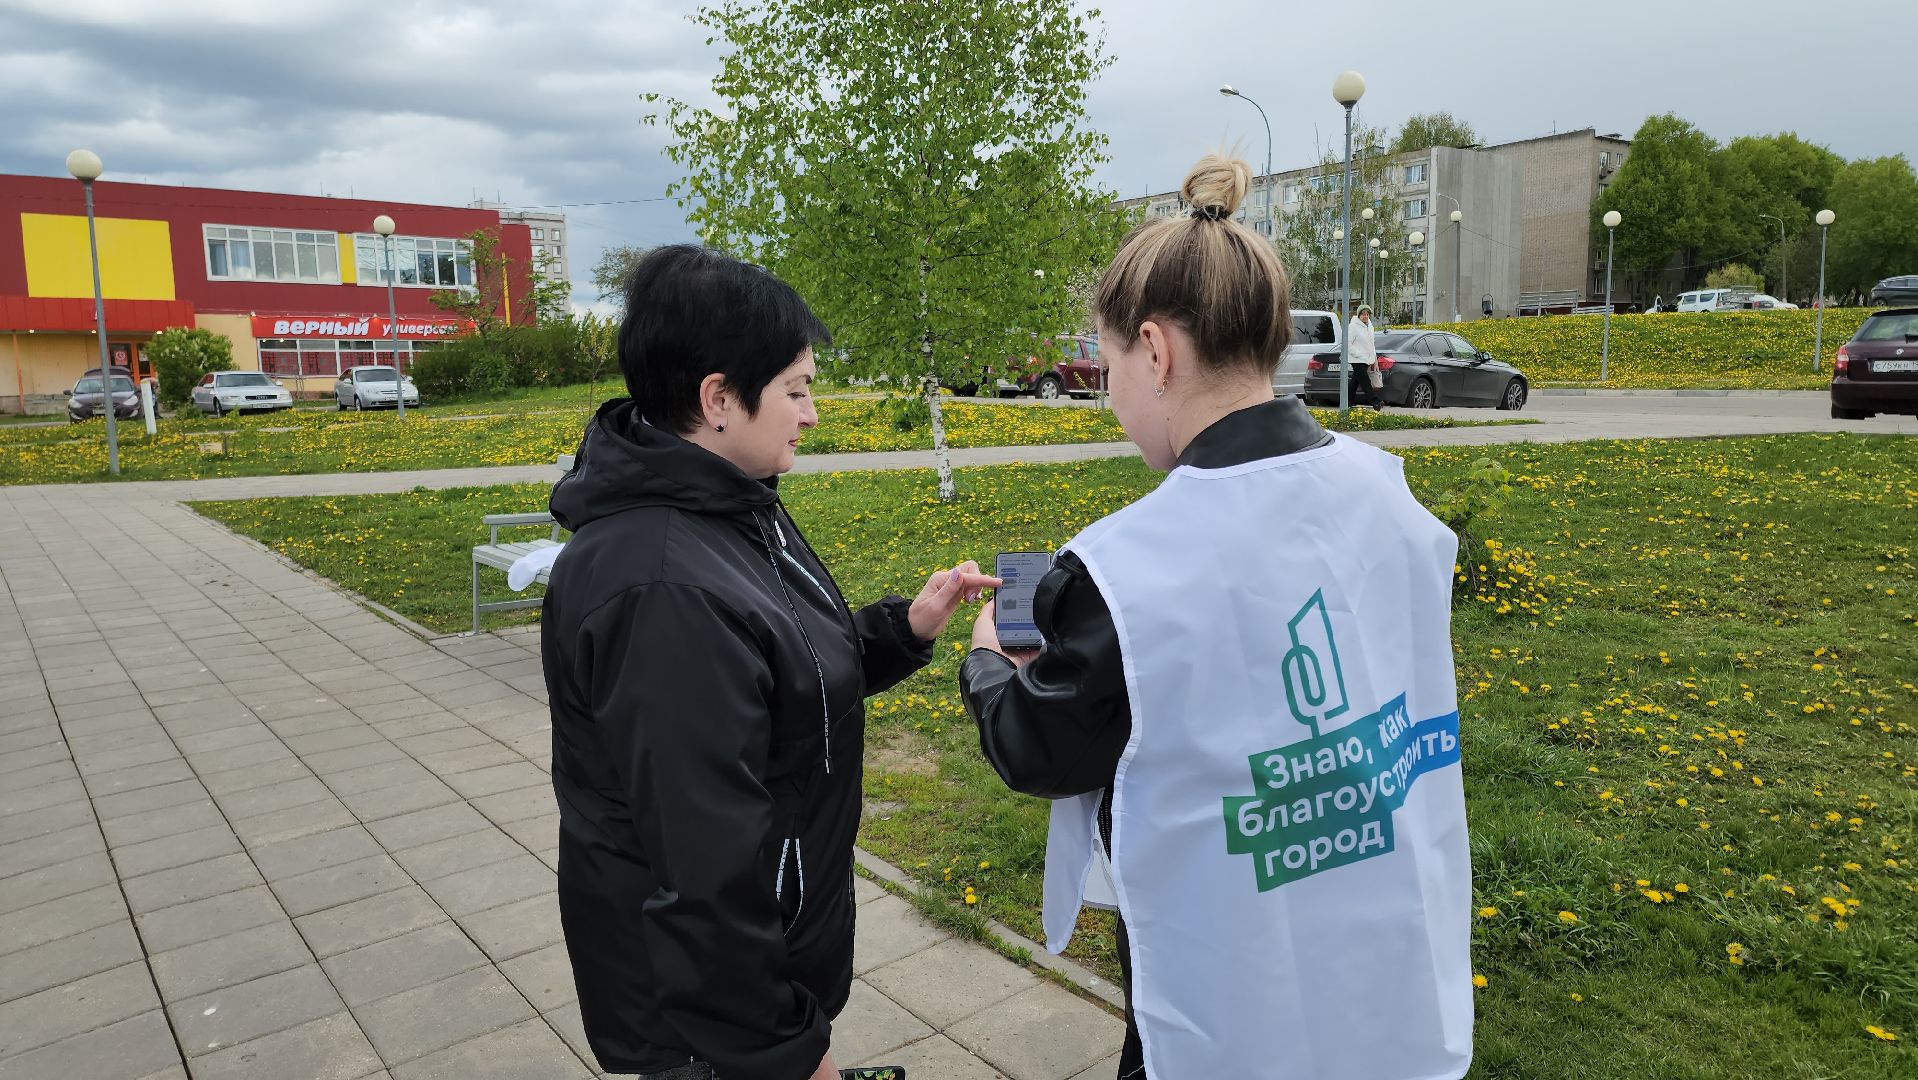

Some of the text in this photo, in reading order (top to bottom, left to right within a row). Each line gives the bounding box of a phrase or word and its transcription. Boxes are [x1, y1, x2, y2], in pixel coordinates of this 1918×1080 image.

[1237, 729, 1457, 838] благоустроить
[1263, 705, 1409, 789] Знаю, как
[1264, 820, 1386, 878] город
